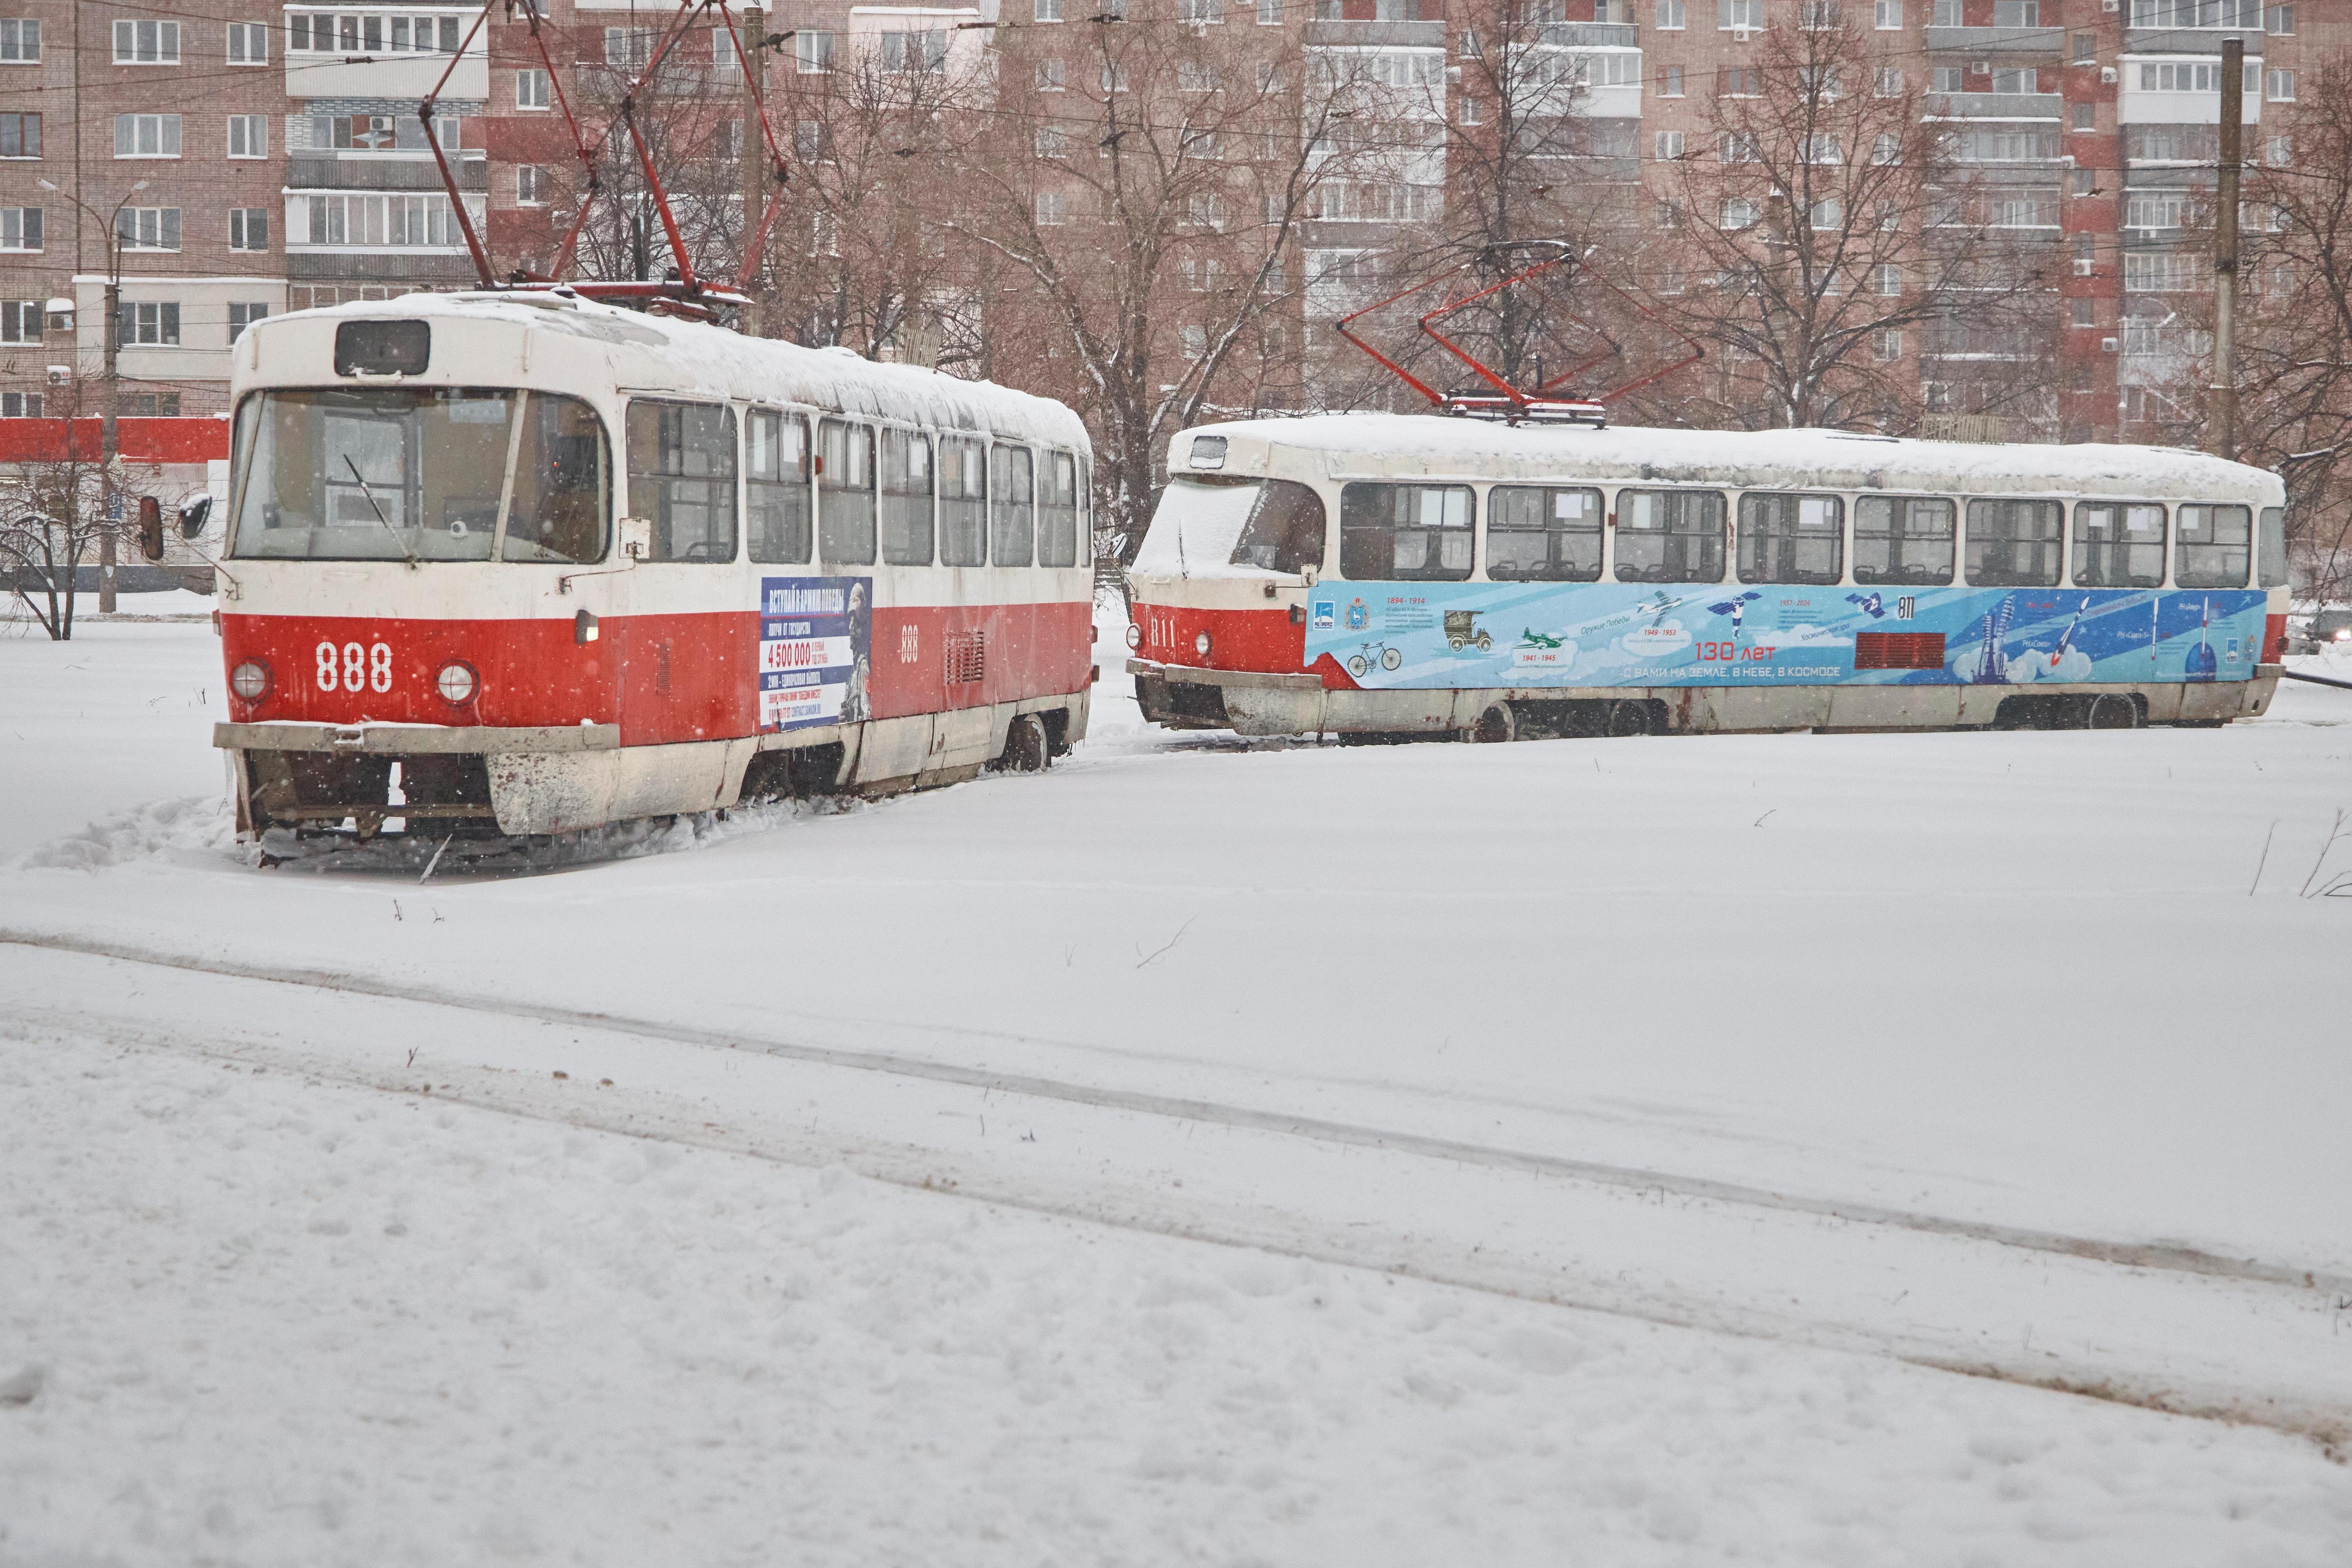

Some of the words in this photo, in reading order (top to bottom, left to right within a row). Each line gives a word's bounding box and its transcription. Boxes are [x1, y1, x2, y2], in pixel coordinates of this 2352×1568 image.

[769, 584, 795, 613] ВСТУПАЙ
[796, 589, 800, 613] В
[800, 589, 821, 612] АРМИЮ
[822, 588, 844, 613] ПОБЕДЫ
[1899, 596, 1915, 619] 811
[788, 622, 810, 636] ГОСУДАРСТВА
[1581, 623, 1605, 635] Оружие
[1606, 616, 1630, 628] Победы
[1801, 628, 1838, 641] Космическая
[1840, 623, 1850, 633] эра
[901, 625, 918, 663] 888
[1695, 641, 1734, 661] 130
[1741, 647, 1776, 660] лет
[768, 644, 774, 668] 4
[776, 643, 792, 668] 500
[795, 642, 810, 666] 000
[316, 641, 392, 693] 888
[1624, 668, 1631, 678] С
[1635, 668, 1667, 678] ВАМИ
[1670, 668, 1686, 677] НА
[1733, 667, 1740, 677] В
[1743, 667, 1774, 678] НЕБЕ,
[1778, 667, 1785, 677] В
[1788, 667, 1841, 676] КОСМОСЕ
